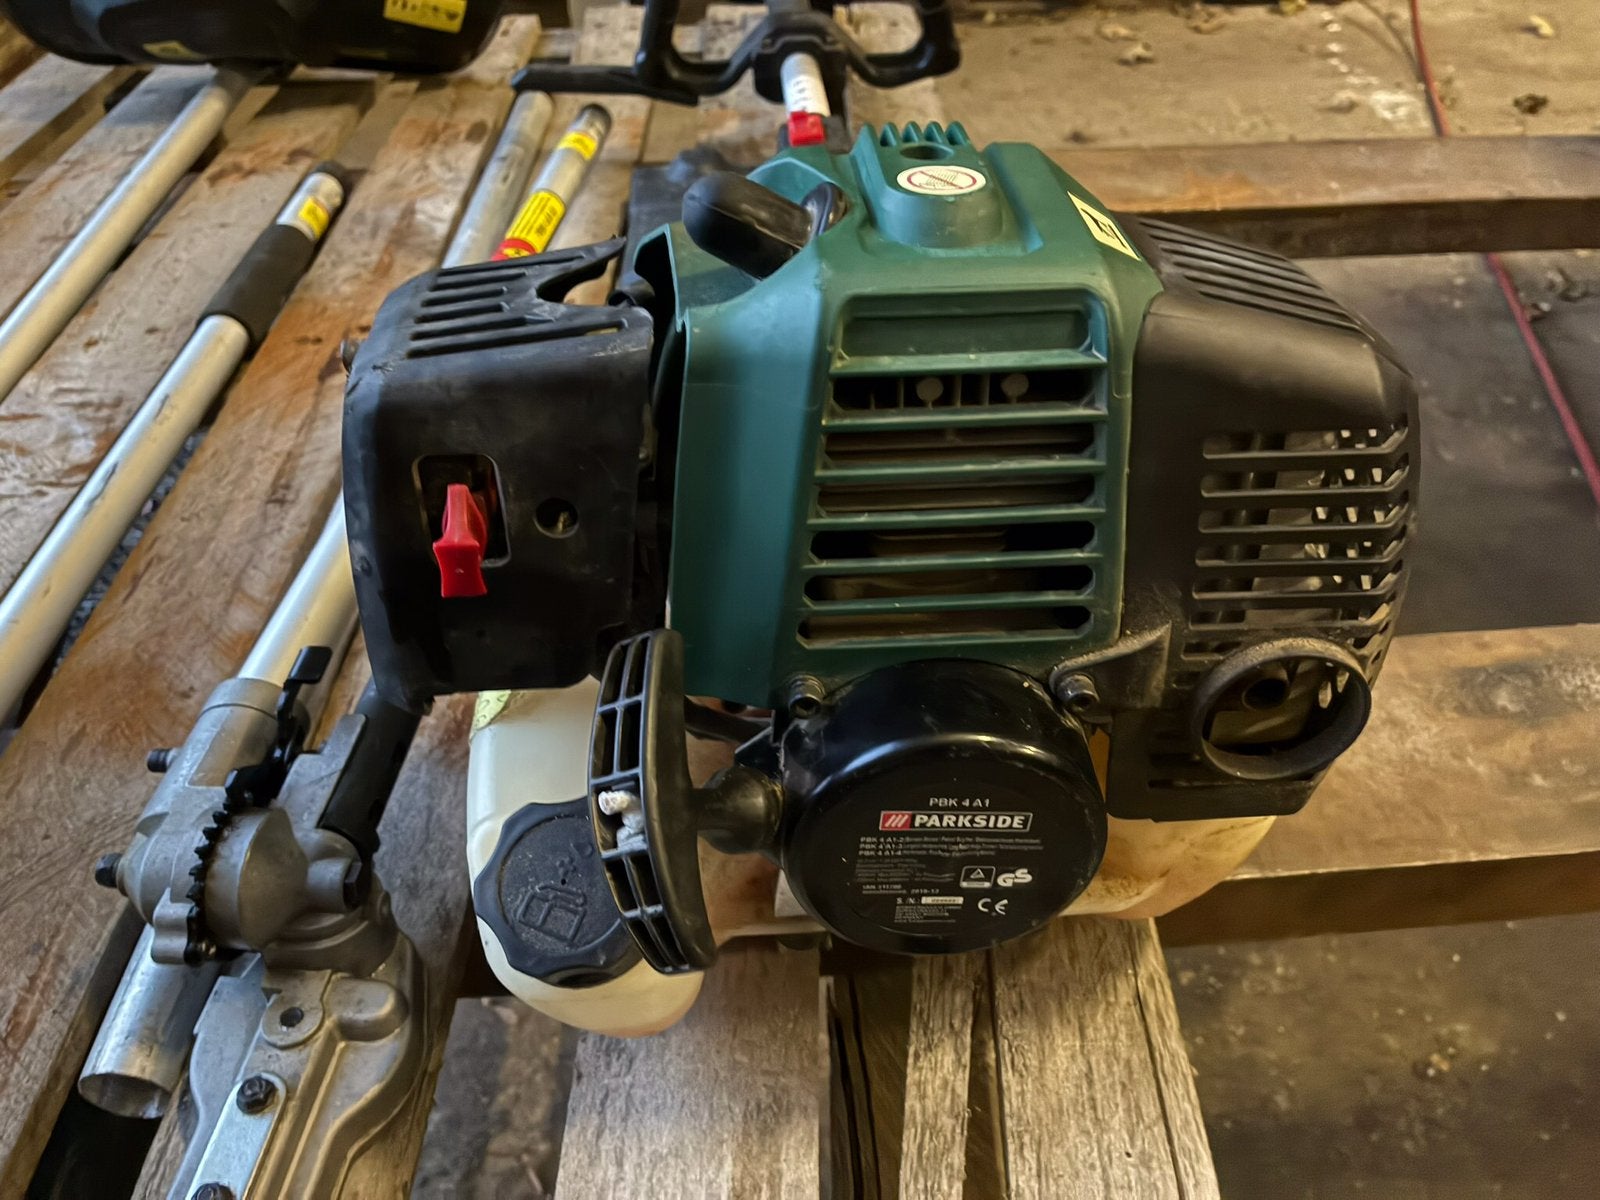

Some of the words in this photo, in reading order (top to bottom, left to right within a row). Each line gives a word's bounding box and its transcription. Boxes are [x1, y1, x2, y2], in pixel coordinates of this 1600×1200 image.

[929, 797, 958, 807] PBK
[961, 798, 970, 807] 4
[972, 798, 990, 808] A1
[914, 814, 1026, 829] PARKSIDE
